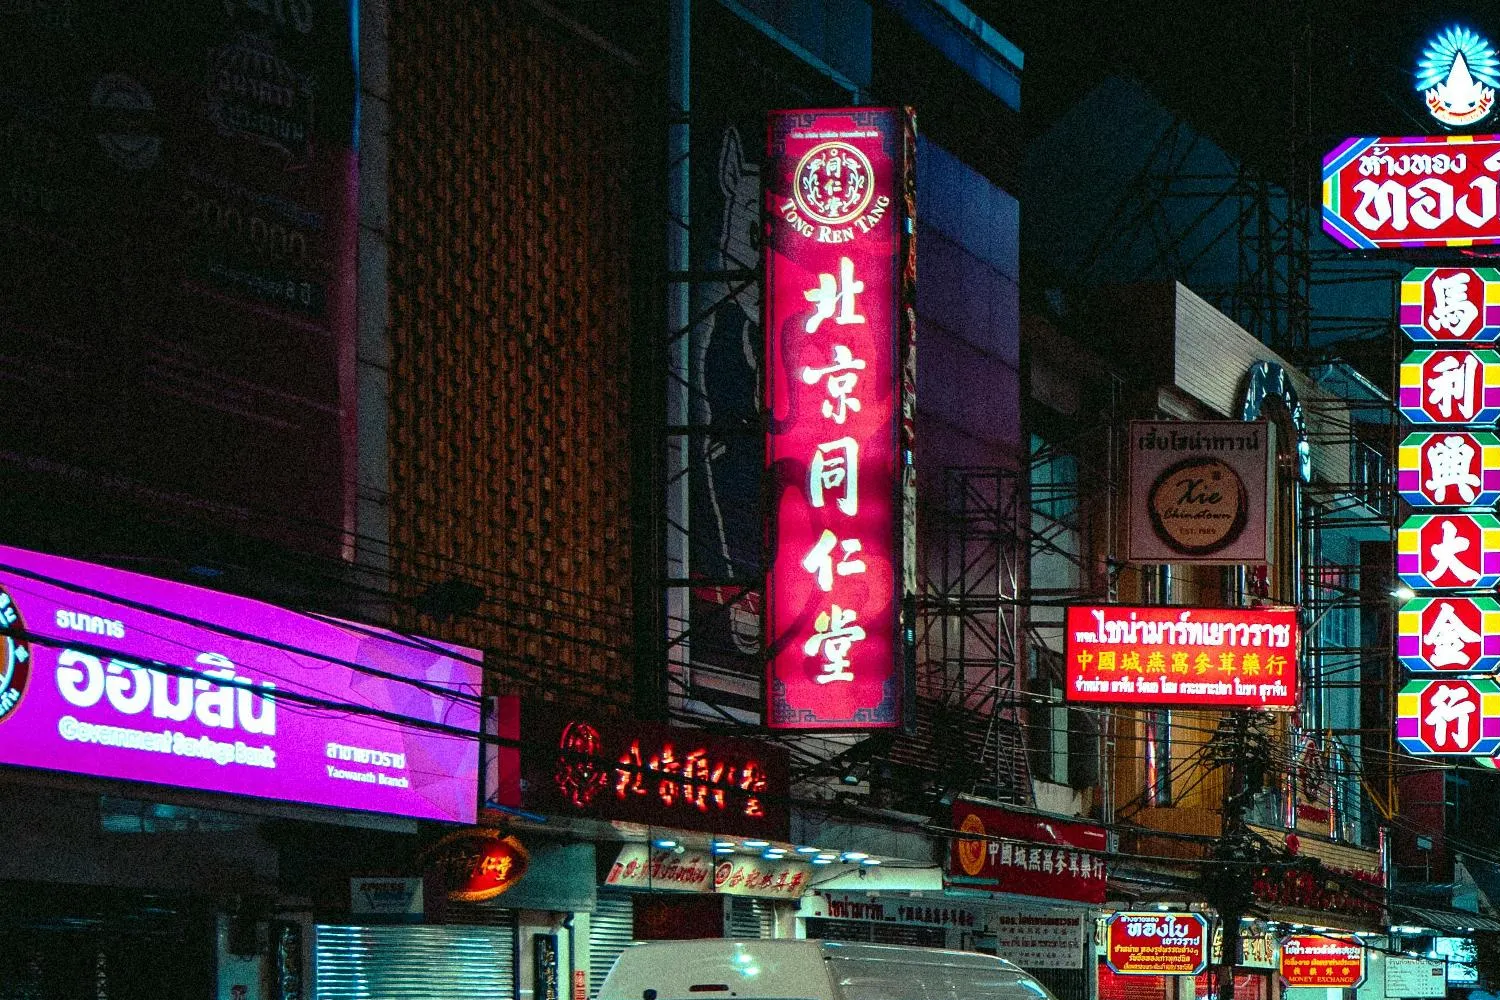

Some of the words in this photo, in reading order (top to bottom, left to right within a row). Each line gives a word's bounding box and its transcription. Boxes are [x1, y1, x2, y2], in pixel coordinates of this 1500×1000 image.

[1358, 146, 1467, 177] ห้างทอง
[817, 225, 855, 243] REN
[801, 256, 866, 685] 北京同仁堂
[1176, 479, 1223, 505] Xie
[1163, 508, 1232, 520] Chinatown
[56, 609, 125, 638] ธนาคาร
[56, 648, 276, 735] ออมสิน
